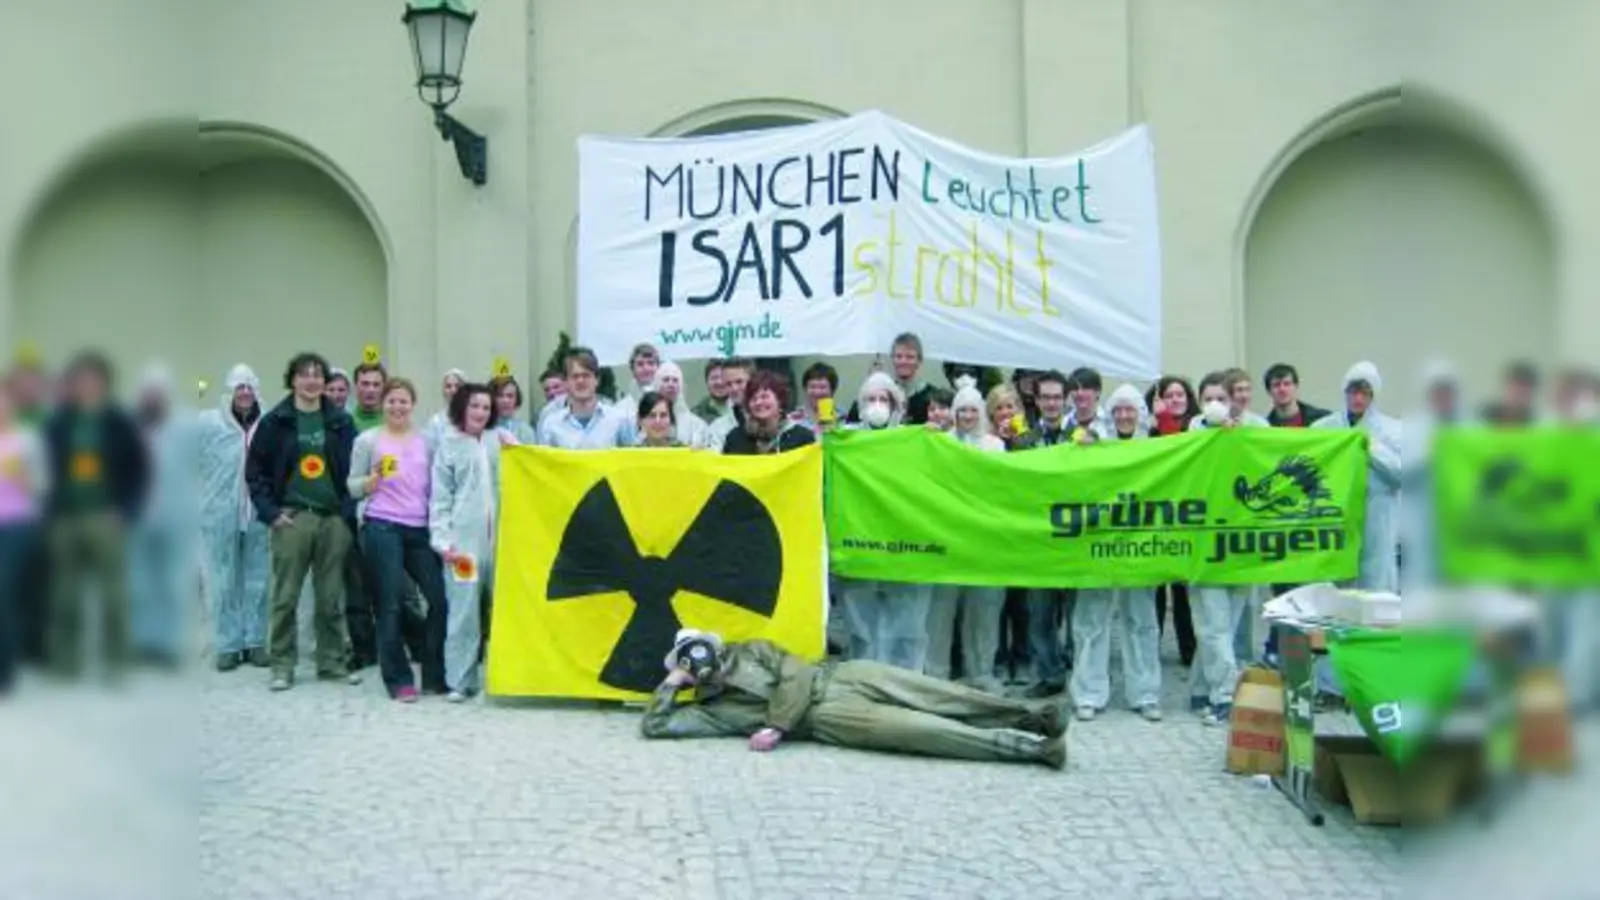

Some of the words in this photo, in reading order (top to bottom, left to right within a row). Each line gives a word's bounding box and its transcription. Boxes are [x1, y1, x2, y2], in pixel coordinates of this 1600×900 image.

[645, 144, 900, 221] MÜNCHEN
[853, 208, 1060, 317] strahlt
[1091, 534, 1193, 559] münchen
